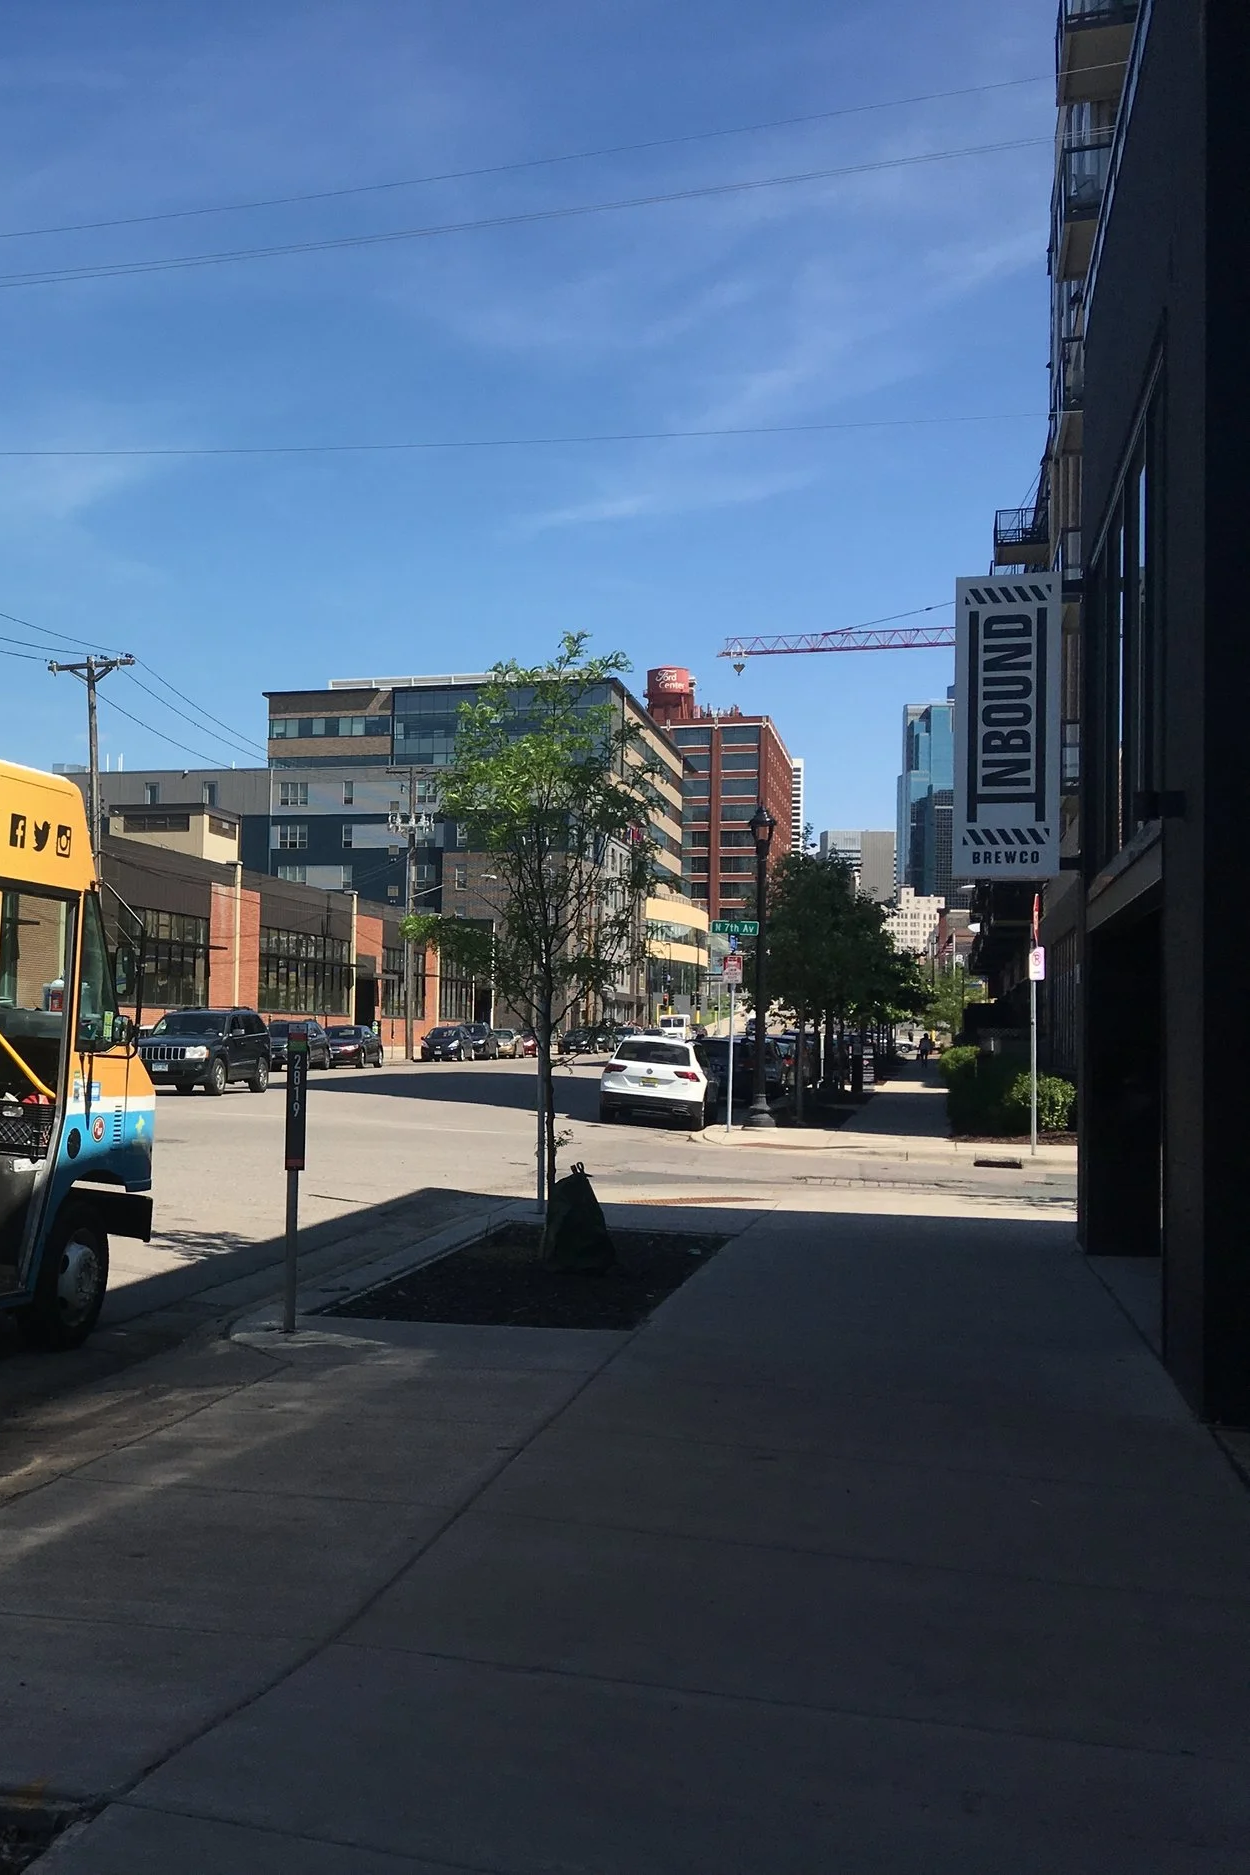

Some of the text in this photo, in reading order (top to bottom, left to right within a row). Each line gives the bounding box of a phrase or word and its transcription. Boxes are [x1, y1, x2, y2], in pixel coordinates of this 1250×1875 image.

[655, 670, 677, 682] Ford
[659, 681, 685, 689] Center
[967, 607, 1048, 823] INBOUND
[972, 851, 1040, 865] BREWCO
[715, 923, 754, 932] N 7th Av
[293, 1054, 301, 1118] 2819
